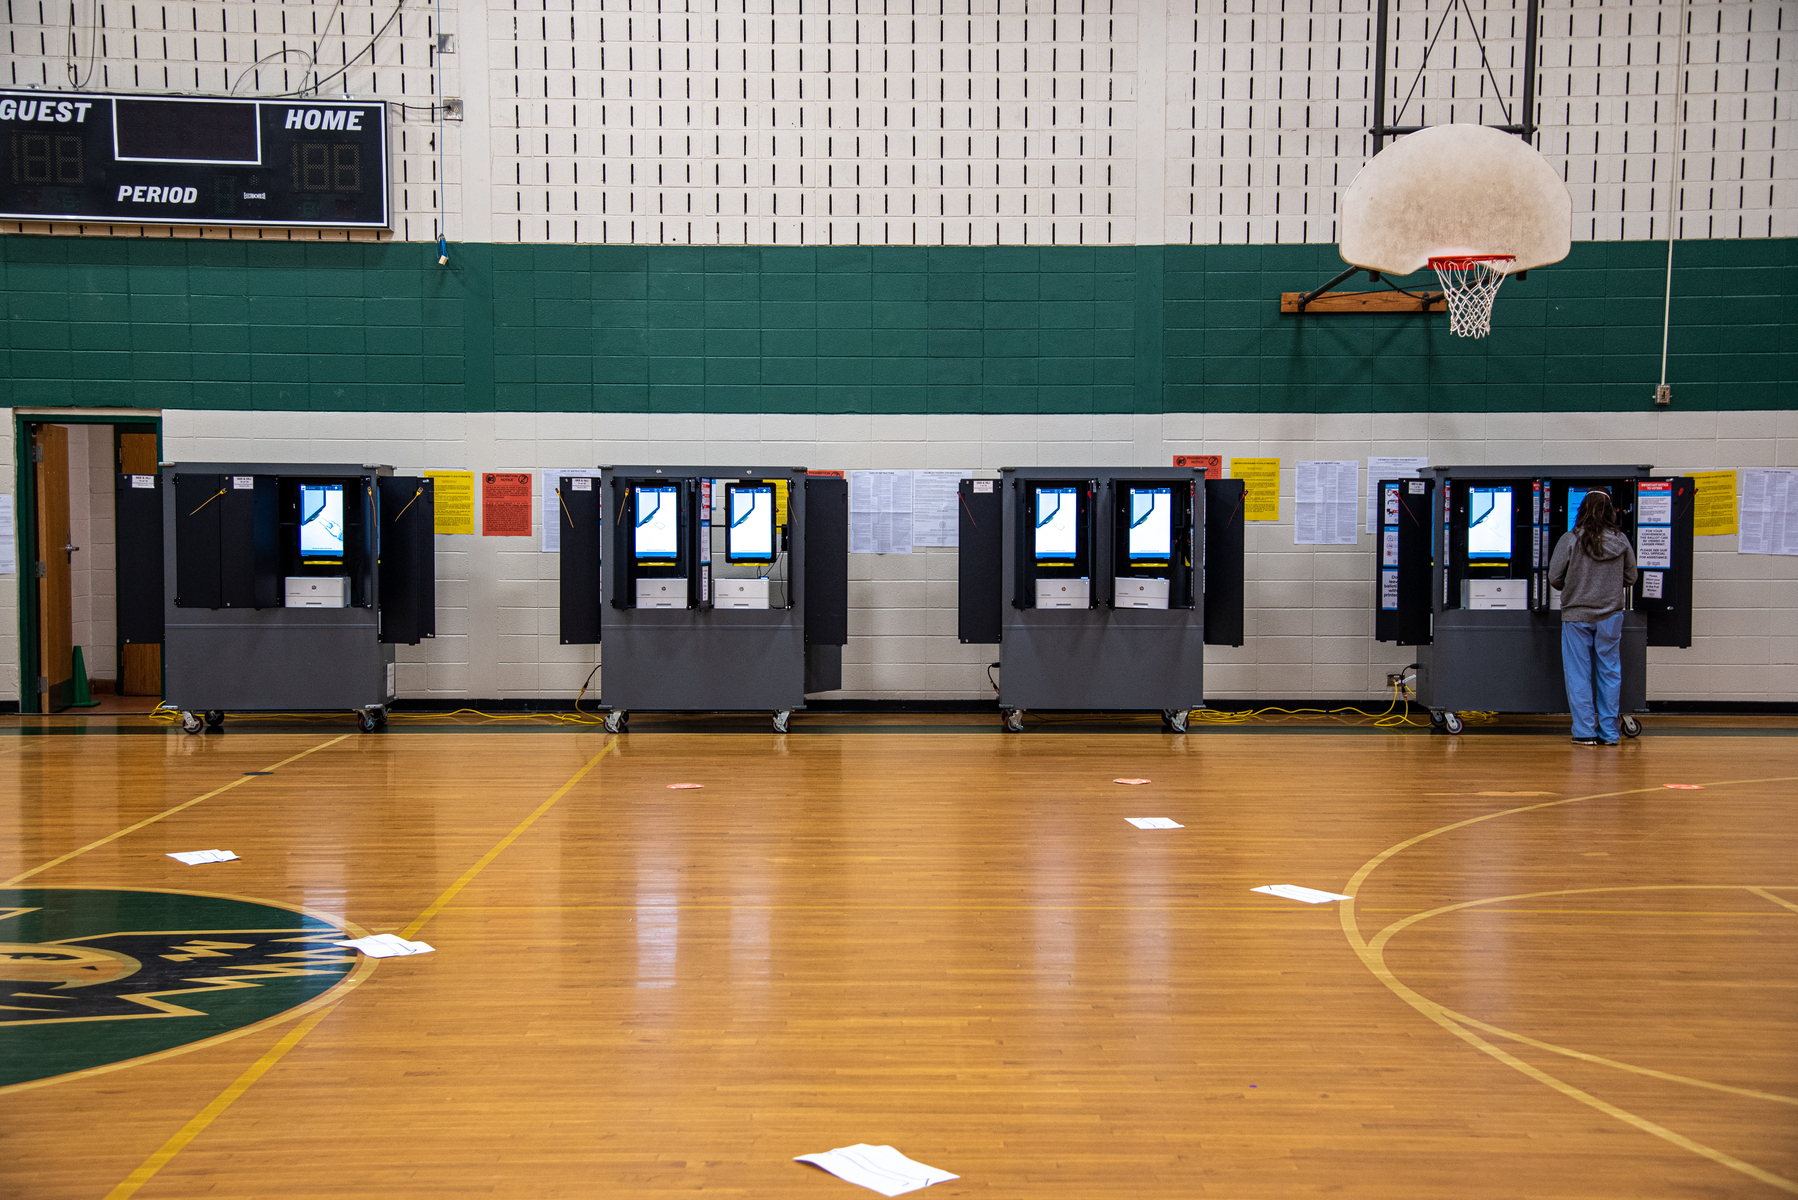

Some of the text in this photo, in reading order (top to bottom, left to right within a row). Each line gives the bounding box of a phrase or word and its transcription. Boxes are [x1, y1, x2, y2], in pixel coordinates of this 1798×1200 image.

[0, 99, 92, 122] GUEST
[285, 109, 365, 130] HOME
[118, 185, 198, 203] PERIOD
